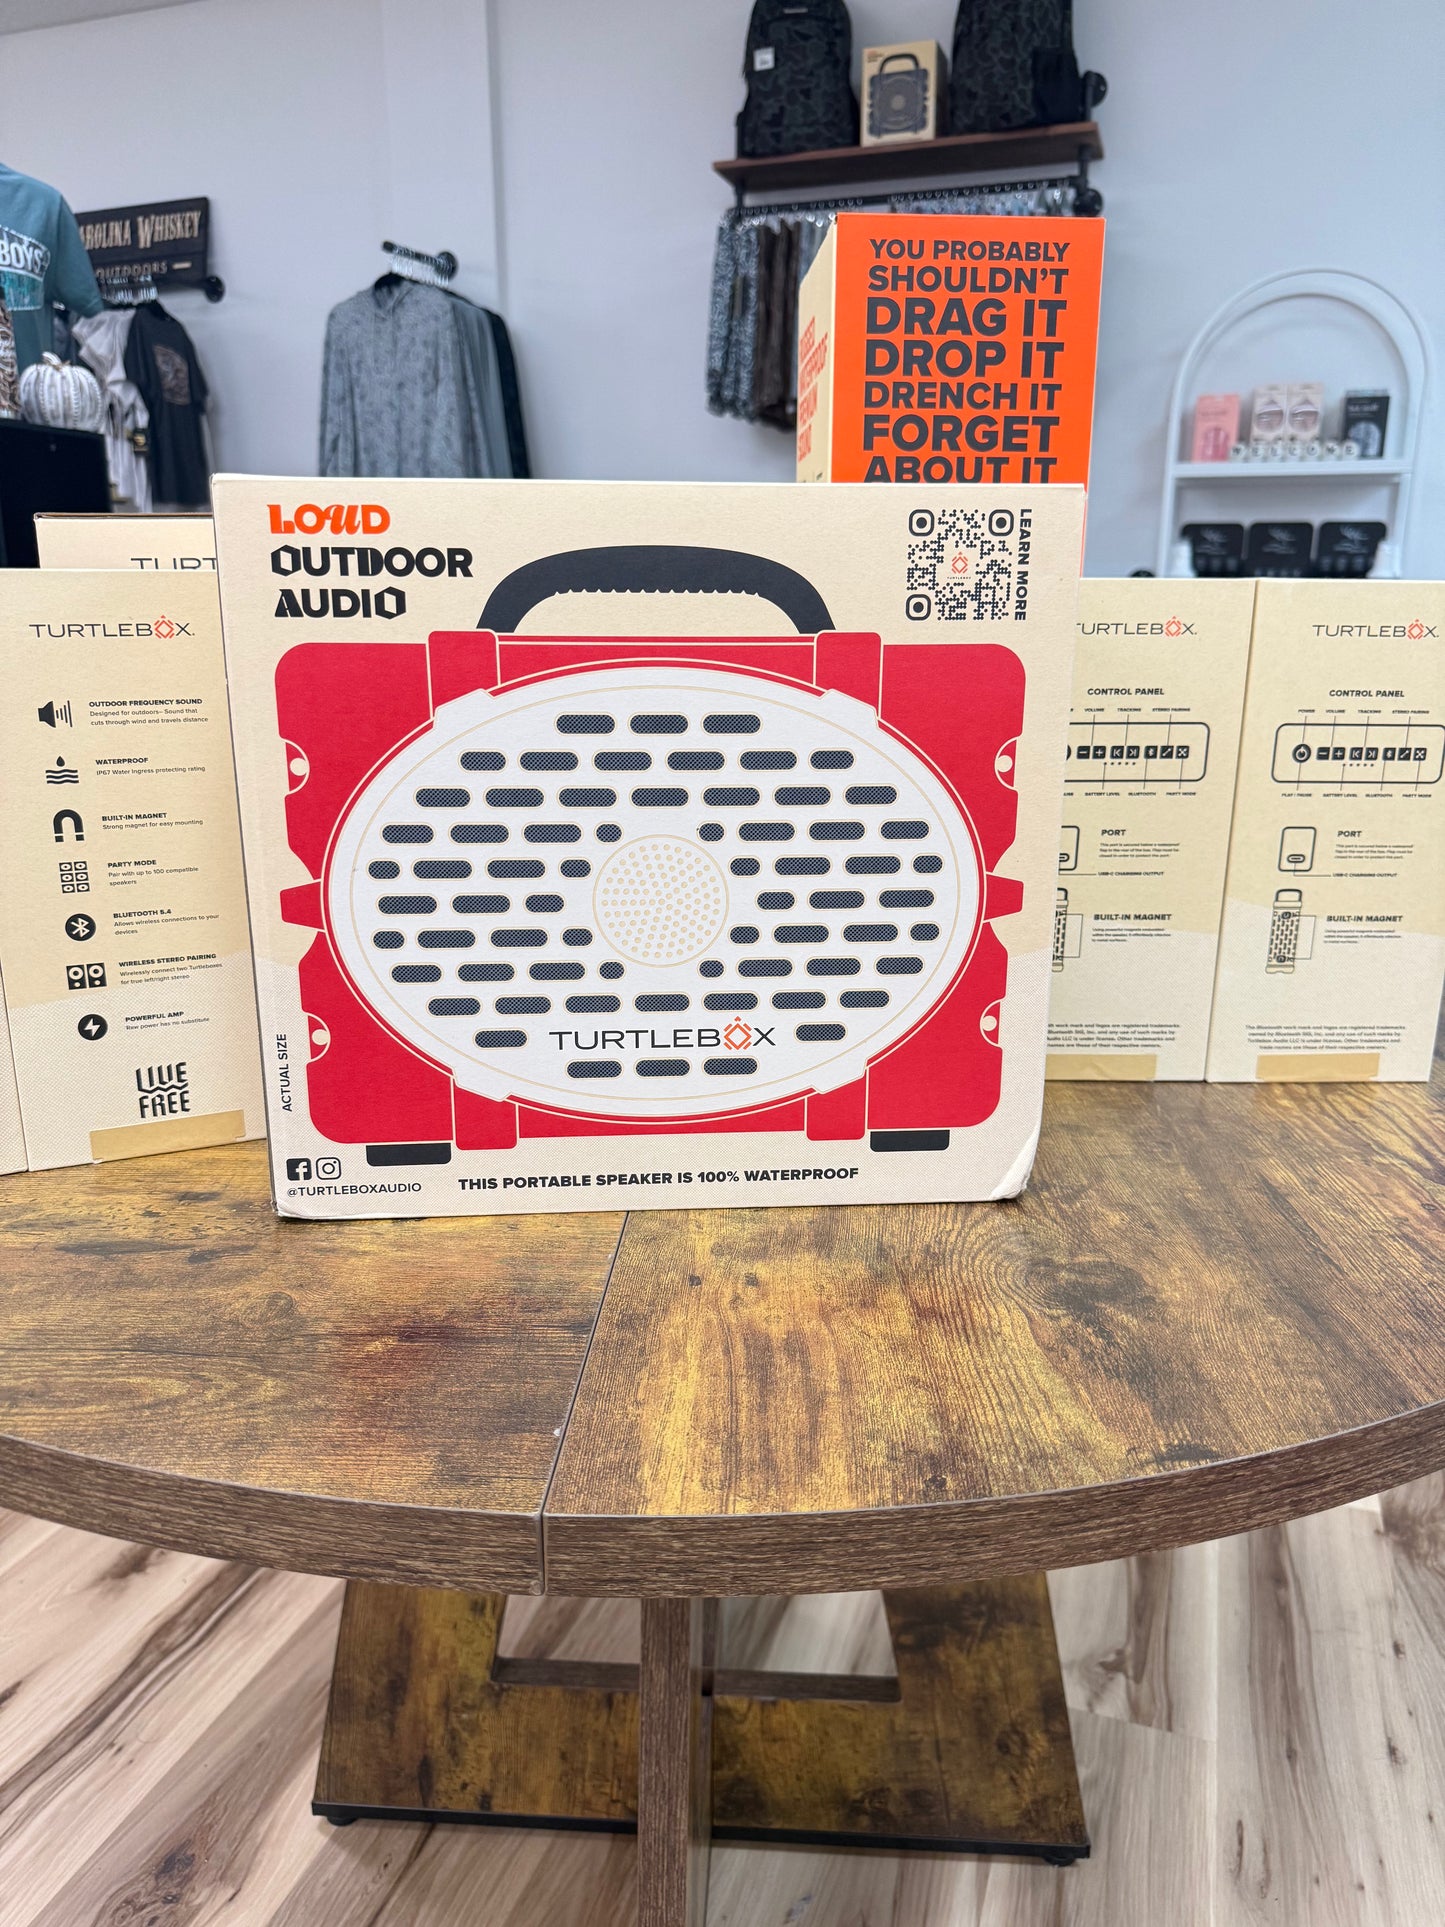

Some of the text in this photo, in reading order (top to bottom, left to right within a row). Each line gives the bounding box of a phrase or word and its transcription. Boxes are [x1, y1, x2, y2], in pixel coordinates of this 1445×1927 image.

[870, 239, 1070, 262] YOU PROBABLY
[868, 265, 1069, 294] SHOULDN’T
[866, 297, 1067, 337] DRAG IT
[866, 339, 1006, 378] DROP
[1021, 342, 1064, 378] IT
[864, 381, 1062, 410] DRENCH IT
[863, 414, 1060, 452] FORGET
[864, 456, 1058, 483] ABOUT IT
[267, 504, 390, 535] LOUD
[270, 544, 473, 578] OUTDOOR
[1014, 509, 1032, 620] LEARN MORE
[274, 586, 406, 620] AUDIO
[1329, 690, 1405, 698] CONTROL PANEL
[113, 910, 158, 919] BLUETOOTH
[119, 959, 156, 968] WIRELESS
[126, 1014, 166, 1022] POWERFUL
[549, 1016, 776, 1051] TURTLEBOX
[136, 1062, 188, 1093] LIVE
[276, 1034, 292, 1112] ACTUAL SIZE
[140, 1090, 191, 1118] FREE
[287, 1182, 422, 1196] @TURTLEBOXAUDIO
[458, 1166, 859, 1190] THIS PORTABLE SPEAKER IS 100% WATERPROOF
